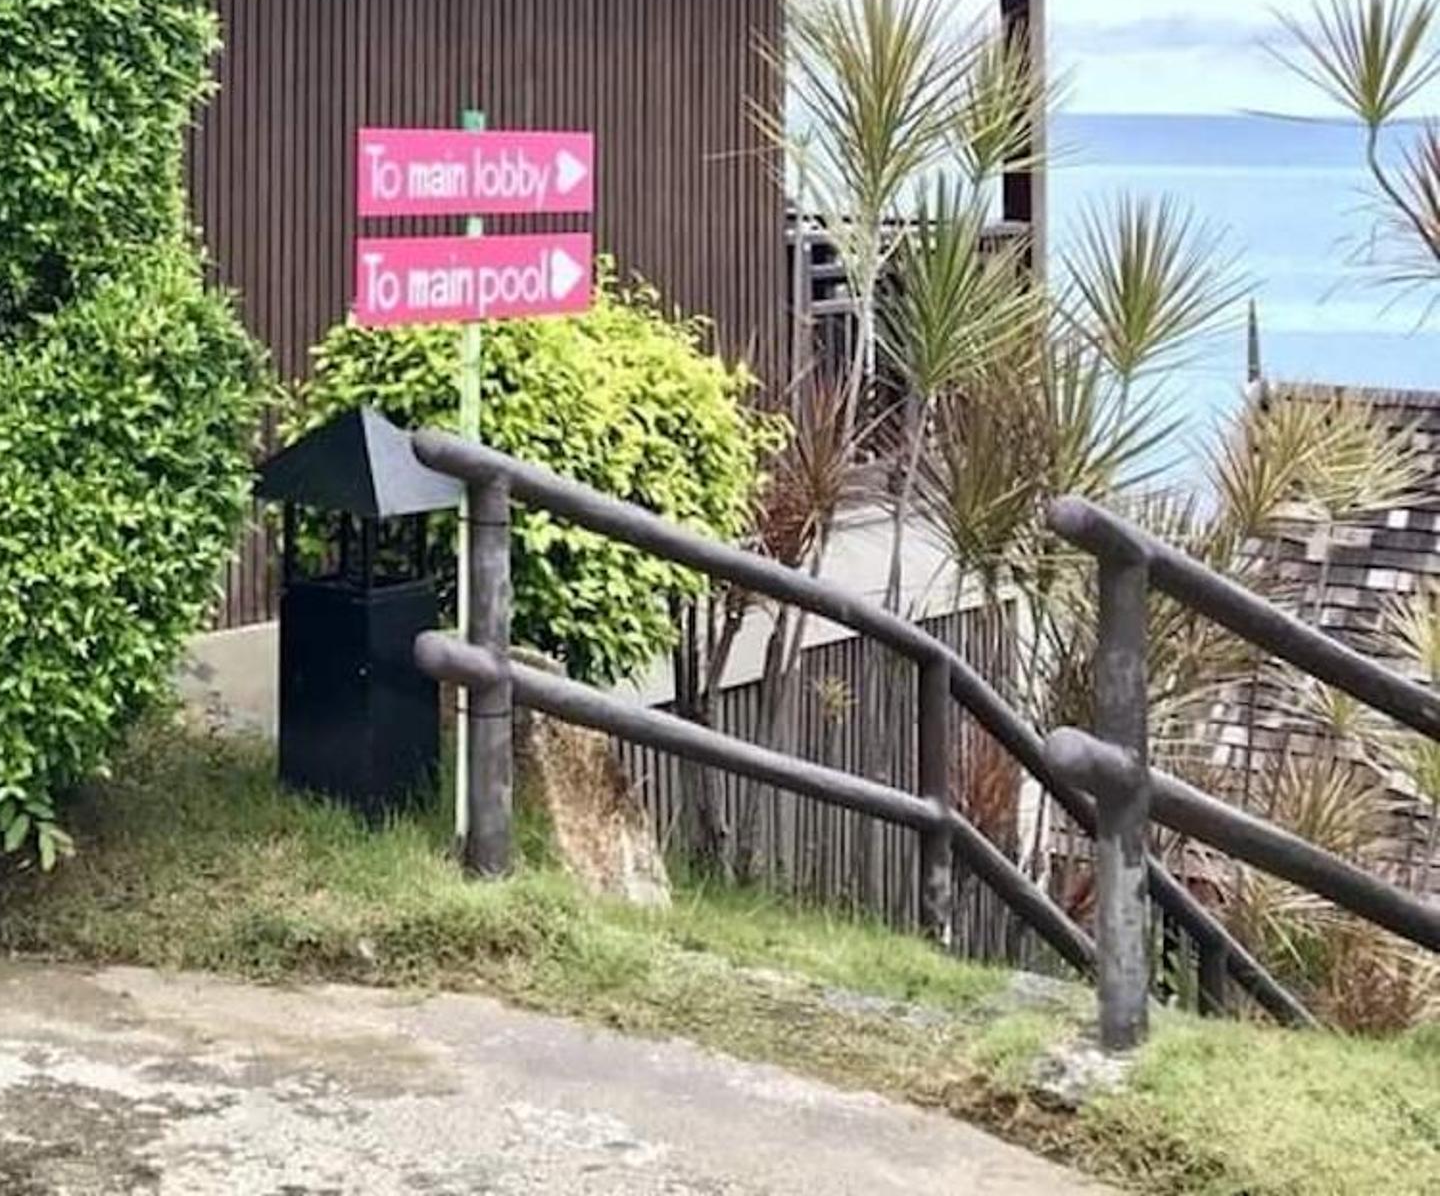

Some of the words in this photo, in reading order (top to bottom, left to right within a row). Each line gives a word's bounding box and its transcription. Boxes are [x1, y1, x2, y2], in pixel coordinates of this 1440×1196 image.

[365, 144, 403, 199] To
[408, 151, 468, 198] main
[474, 147, 550, 210] lobby
[363, 253, 400, 312] To
[407, 255, 474, 309] main
[478, 250, 548, 318] pool
